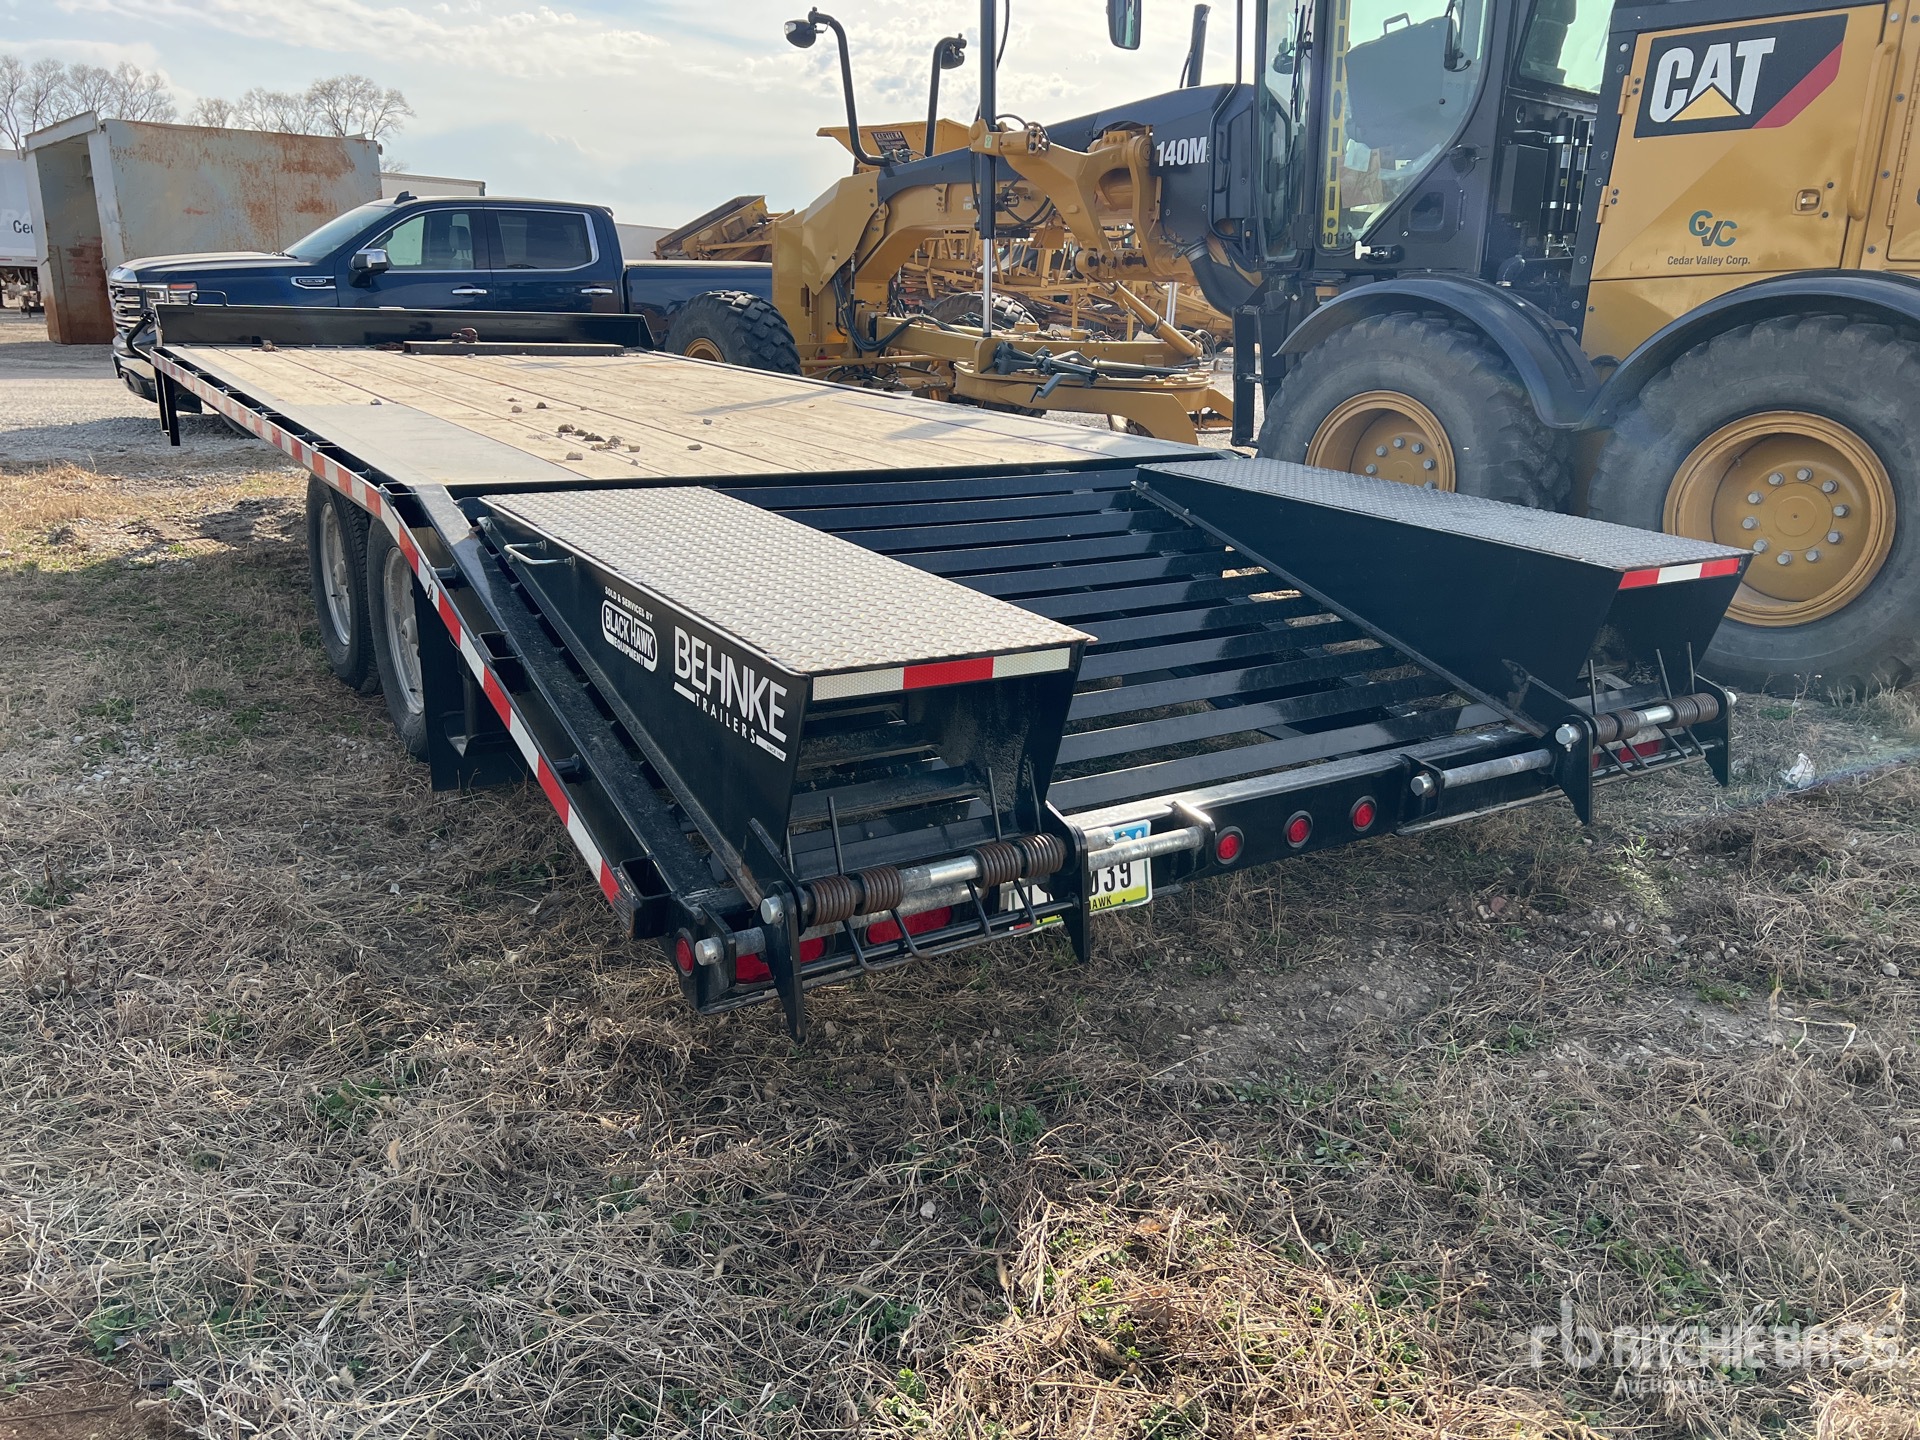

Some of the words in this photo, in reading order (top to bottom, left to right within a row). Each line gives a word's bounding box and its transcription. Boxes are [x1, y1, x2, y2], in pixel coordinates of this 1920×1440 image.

[1650, 37, 1776, 122] CAT
[1156, 136, 1208, 167] 140M
[1322, 232, 1352, 245] 10113
[1688, 209, 1738, 247] CVC
[1667, 255, 1694, 265] Cedar
[1696, 255, 1724, 266] Valley
[1725, 254, 1751, 267] Corp.
[604, 585, 617, 600] SOLD
[617, 593, 622, 603] &
[645, 610, 653, 622] BY
[605, 606, 630, 643] BLACK
[630, 616, 654, 659] HAWK
[613, 637, 645, 666] EQUIPMENT
[674, 625, 788, 743] BEHNKE
[695, 692, 757, 744] TRAILERS
